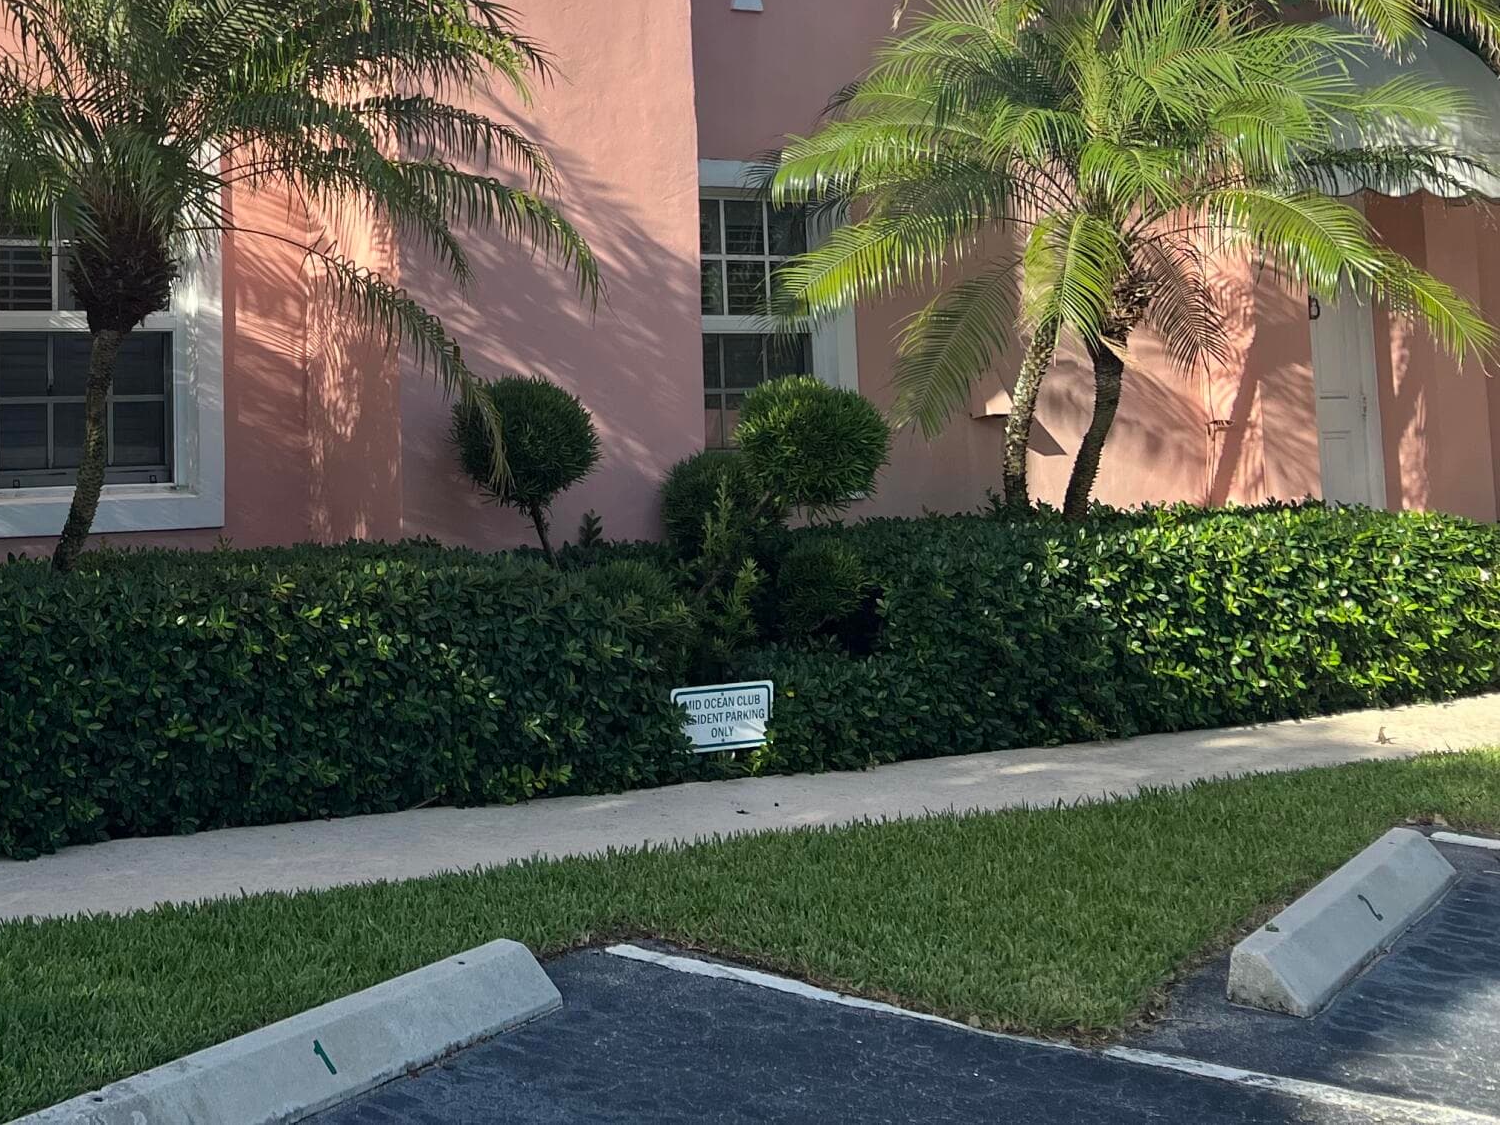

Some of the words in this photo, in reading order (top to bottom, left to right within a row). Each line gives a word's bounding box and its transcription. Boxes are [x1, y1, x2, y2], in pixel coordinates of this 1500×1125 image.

[685, 699, 701, 711] MID
[704, 696, 735, 709] OCEAN
[737, 694, 761, 706] CLUB
[684, 712, 723, 726] SIDENT
[725, 708, 765, 722] PARKING
[711, 726, 734, 738] ONLY
[313, 1039, 337, 1075] 1
